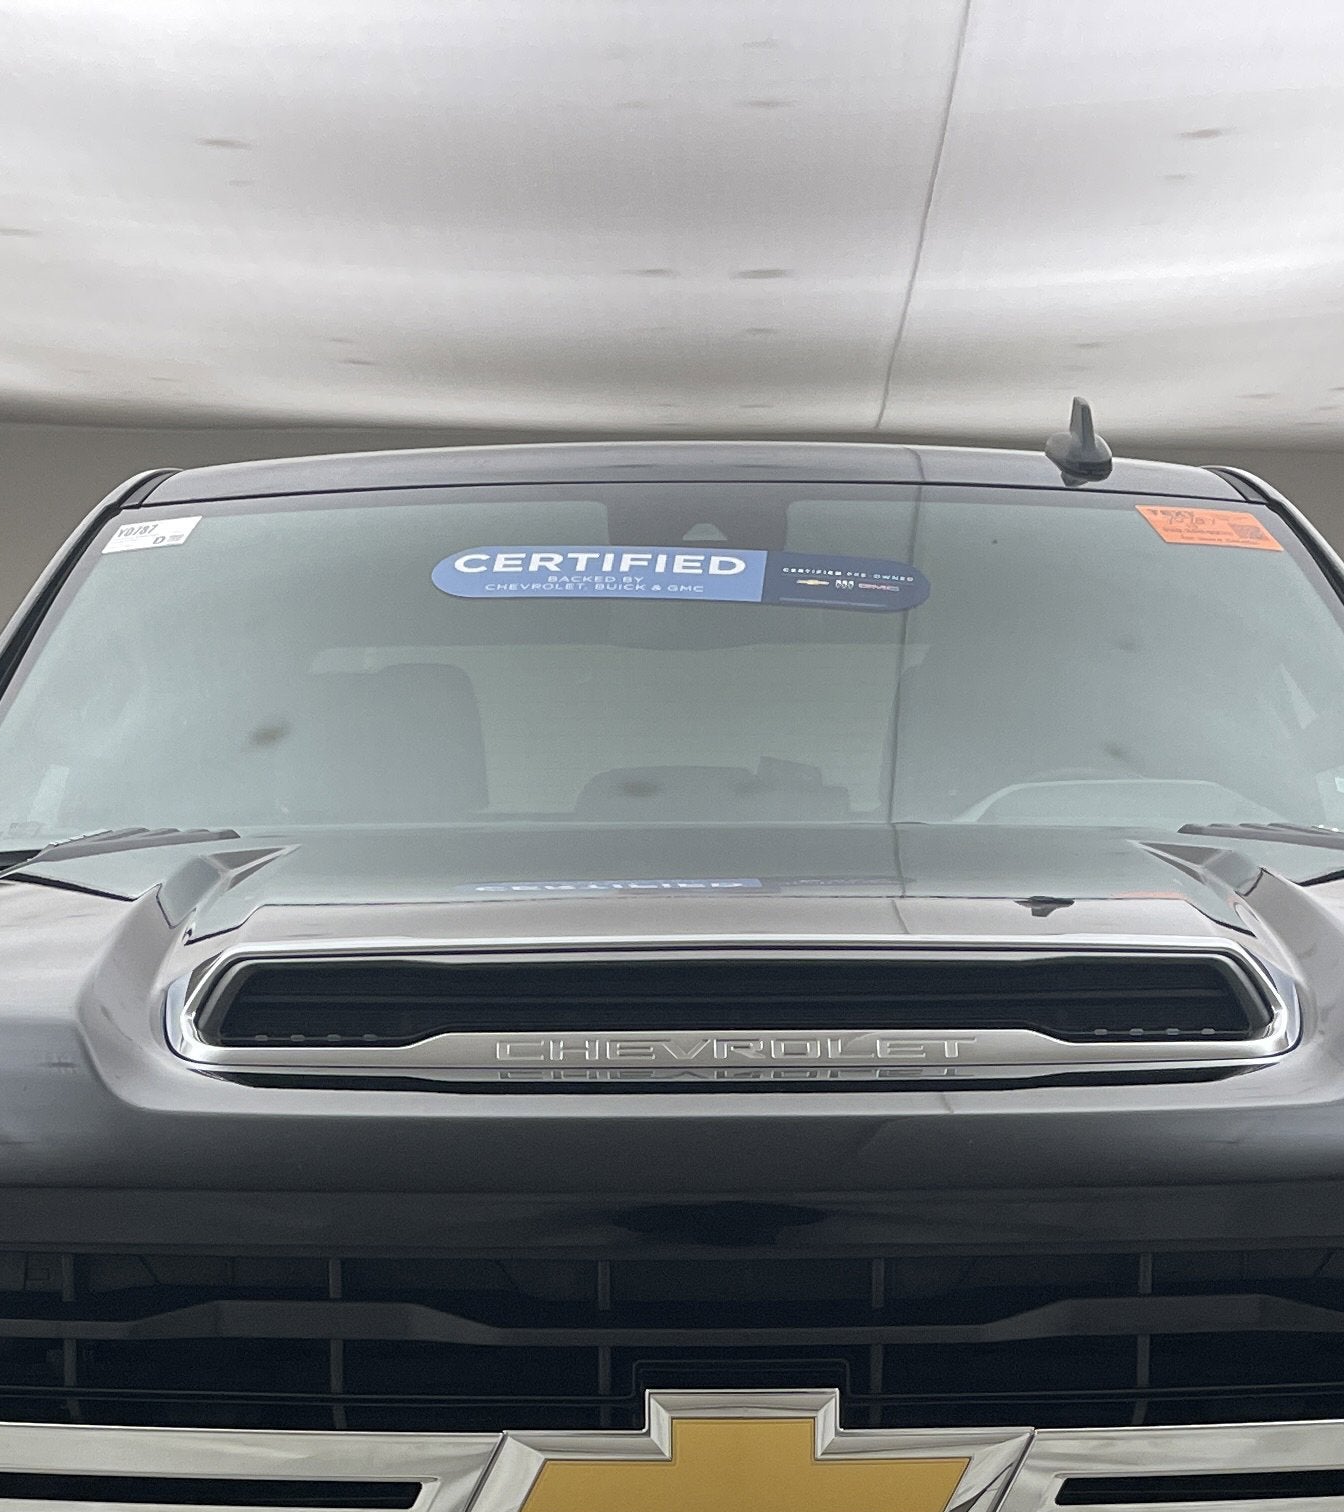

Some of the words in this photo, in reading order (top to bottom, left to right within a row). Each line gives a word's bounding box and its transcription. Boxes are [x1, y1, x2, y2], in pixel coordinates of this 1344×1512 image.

[454, 553, 746, 575] CERTIFIED
[547, 575, 616, 583] BACKED
[594, 583, 647, 592] BUICK
[667, 585, 706, 593] GMC
[496, 1036, 978, 1062] CHEVROLET
